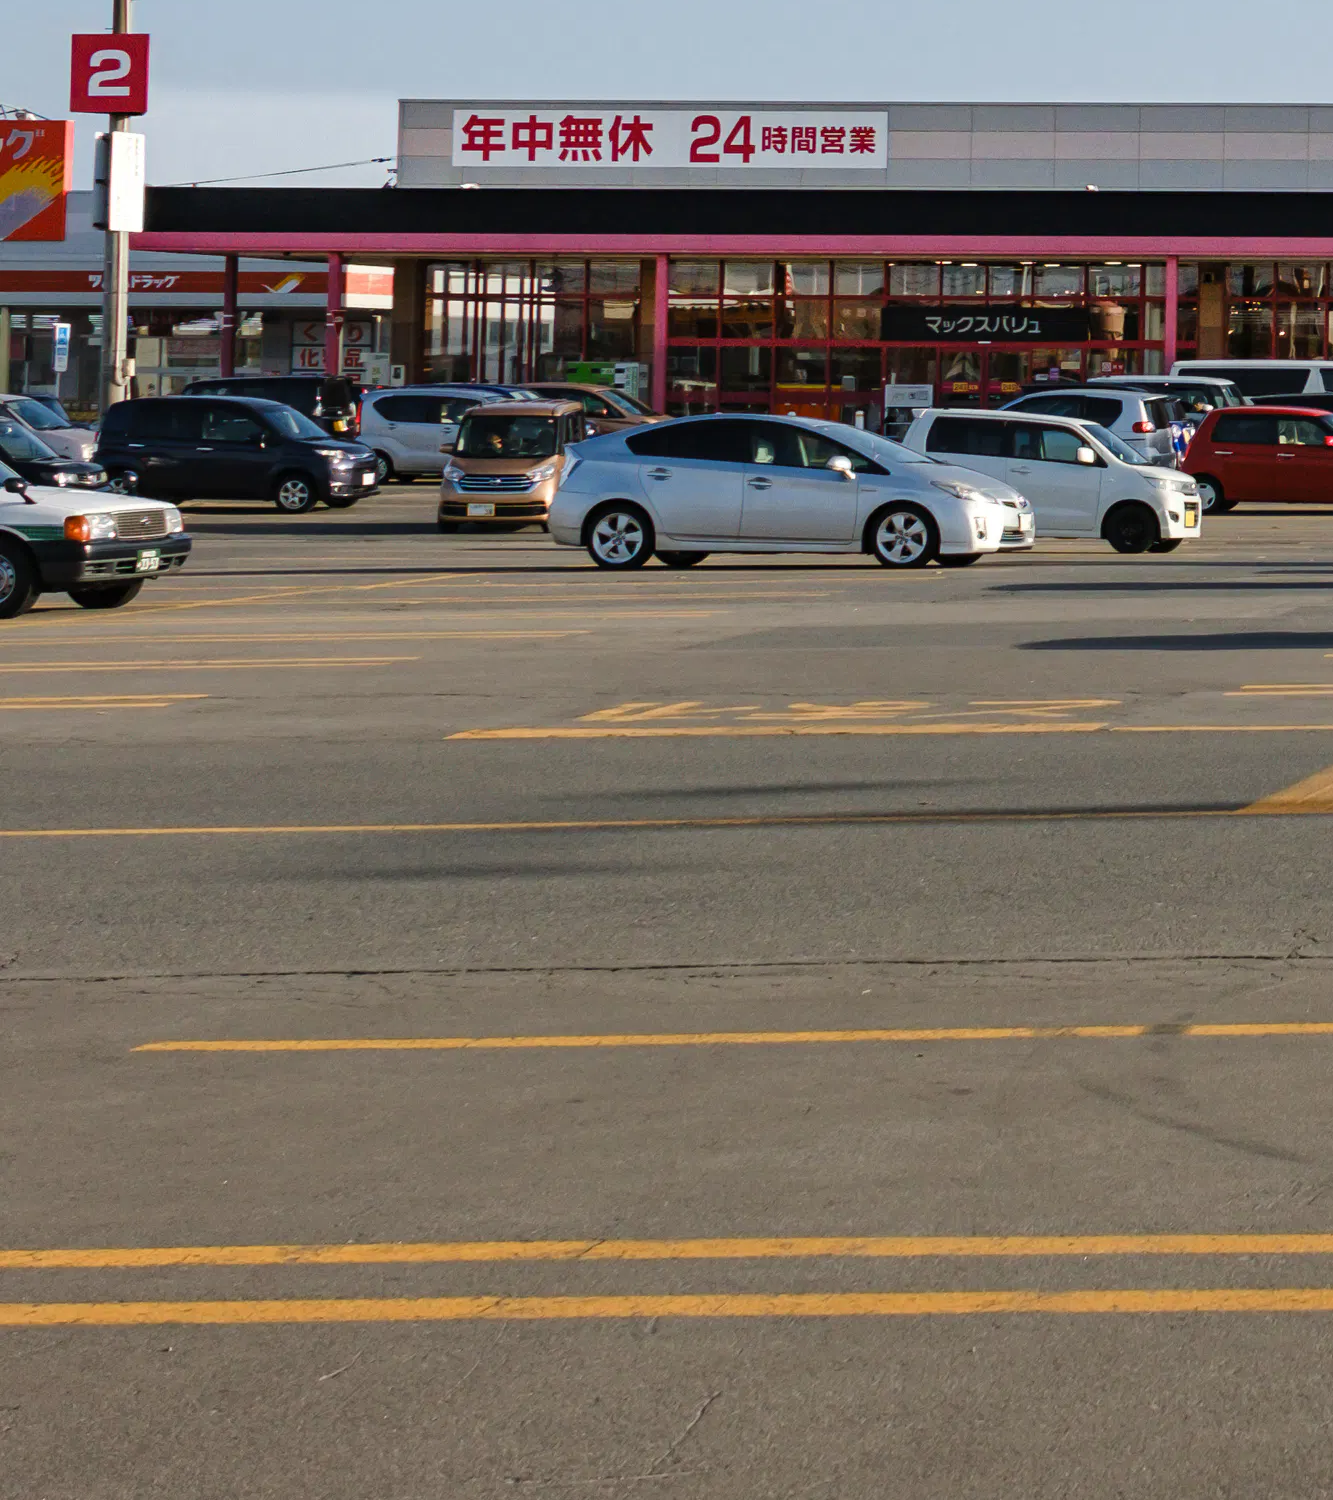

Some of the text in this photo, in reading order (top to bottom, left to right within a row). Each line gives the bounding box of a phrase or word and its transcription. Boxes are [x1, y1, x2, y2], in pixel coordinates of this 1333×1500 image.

[87, 49, 132, 98] 2
[461, 114, 877, 163] 年中無休 24時間営業
[302, 323, 364, 343] くり
[925, 315, 1041, 334] マックスバリュ
[300, 347, 364, 368] 化品
